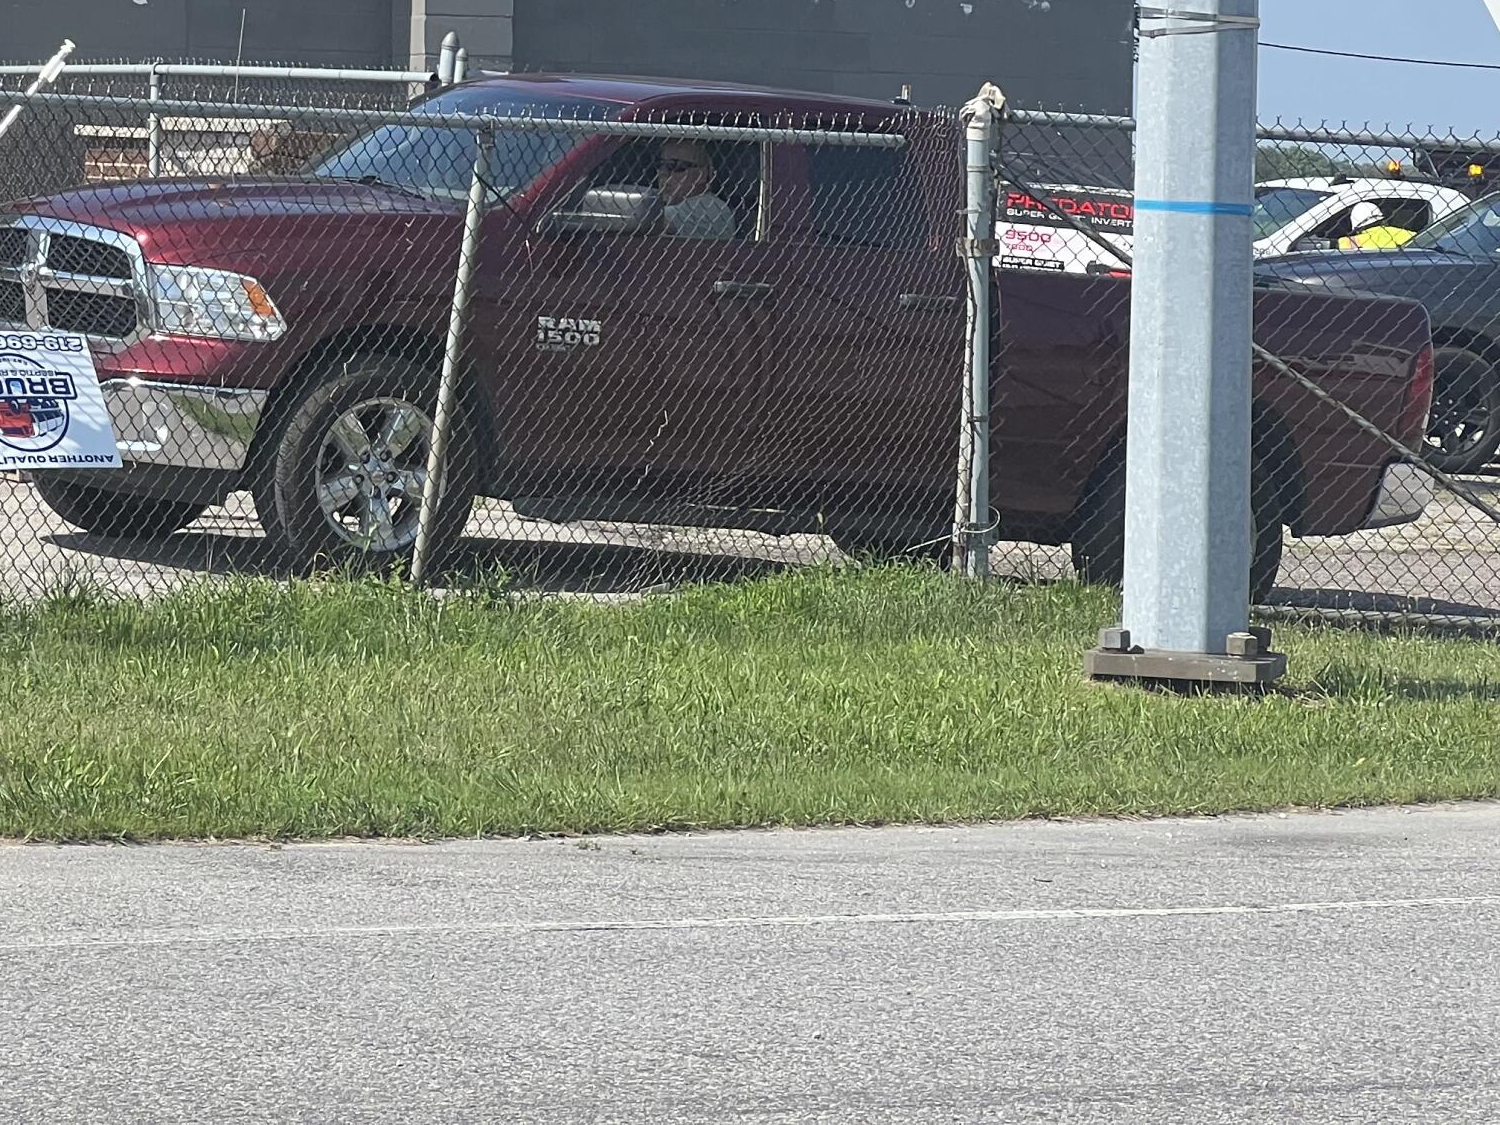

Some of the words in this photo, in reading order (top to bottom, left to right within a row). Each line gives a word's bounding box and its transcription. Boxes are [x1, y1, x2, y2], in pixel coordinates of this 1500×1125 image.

[537, 315, 602, 332] RAM
[537, 329, 600, 346] 1500
[49, 454, 114, 464] ANOTHER
